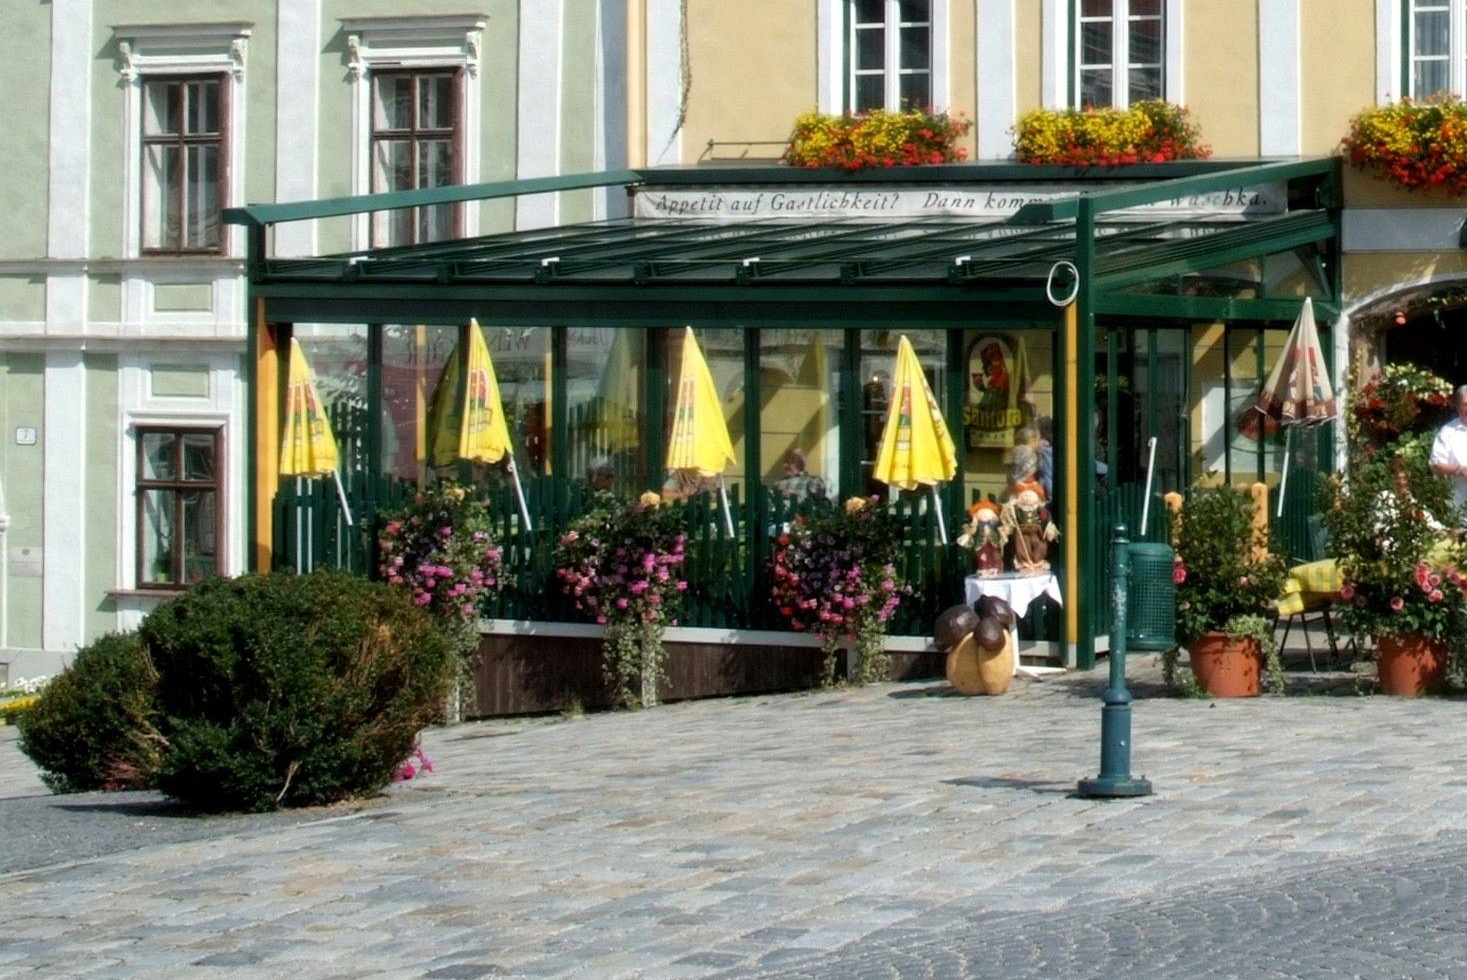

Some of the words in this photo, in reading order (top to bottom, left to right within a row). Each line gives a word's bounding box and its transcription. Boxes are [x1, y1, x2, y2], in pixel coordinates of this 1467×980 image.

[656, 194, 723, 216] Appetit
[731, 193, 764, 216] auf
[922, 191, 976, 210] Dann
